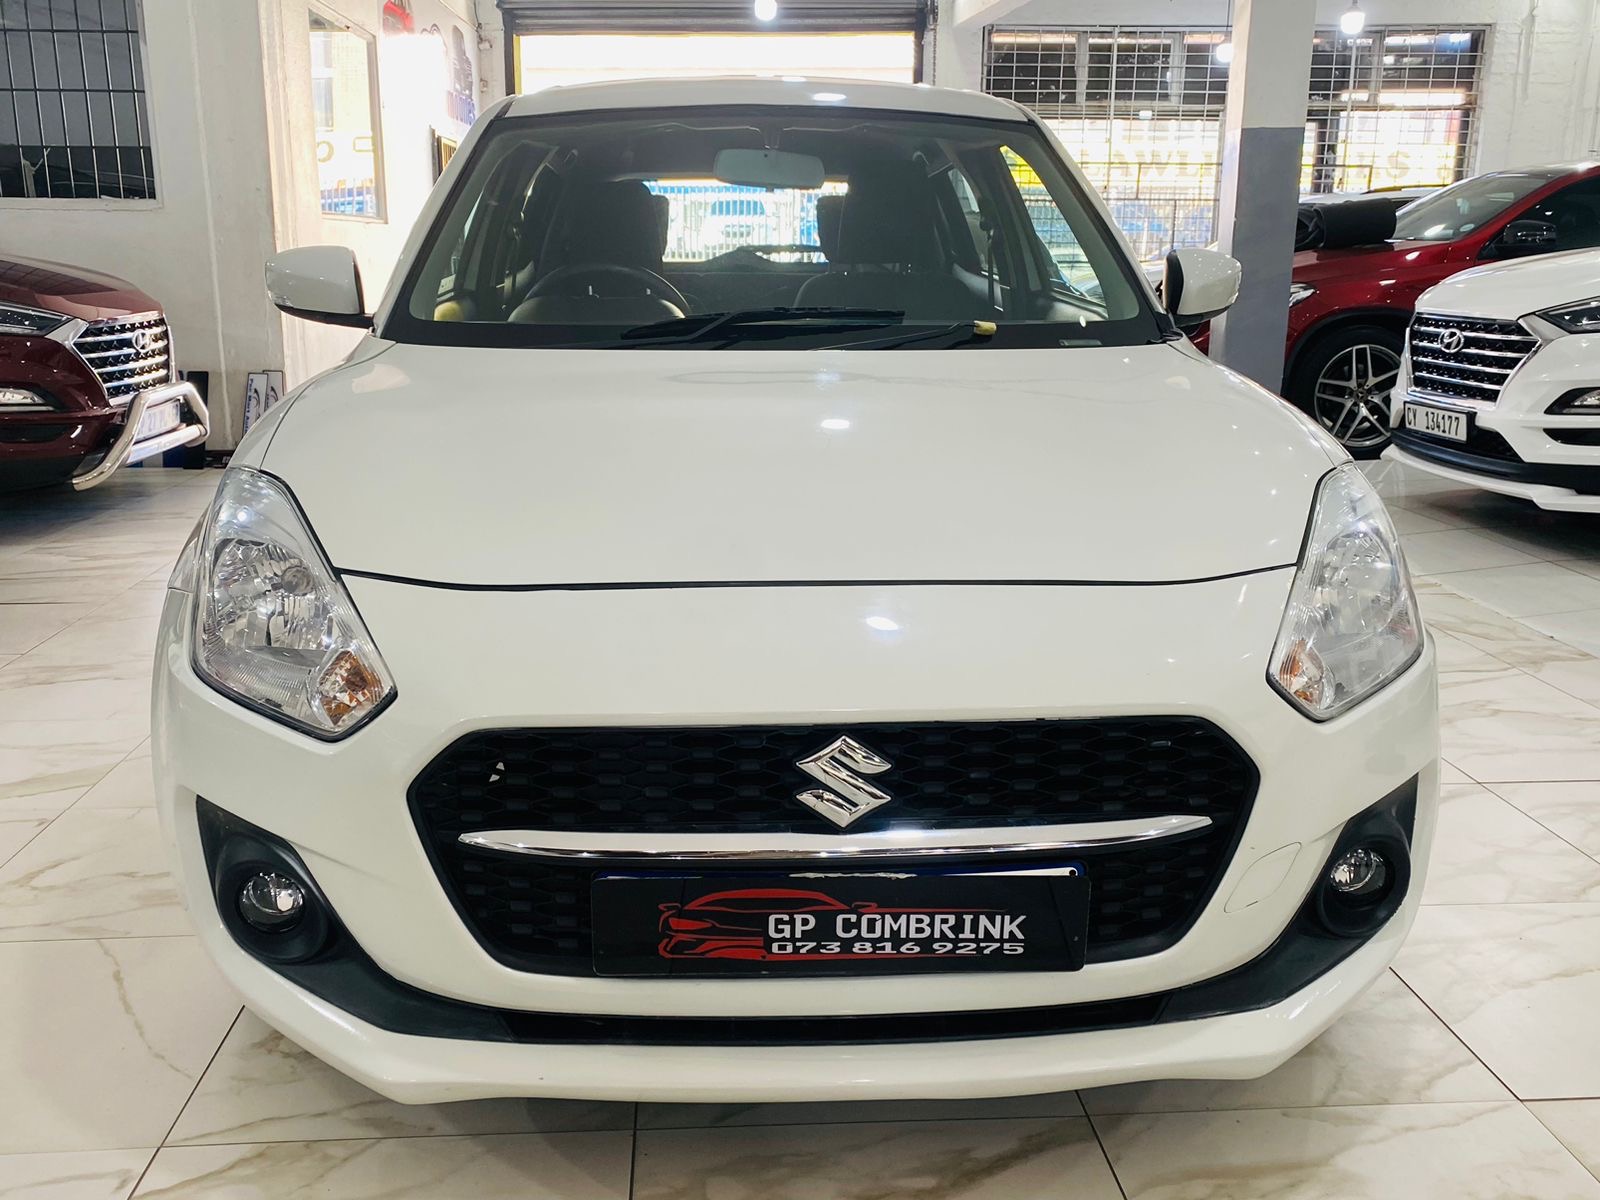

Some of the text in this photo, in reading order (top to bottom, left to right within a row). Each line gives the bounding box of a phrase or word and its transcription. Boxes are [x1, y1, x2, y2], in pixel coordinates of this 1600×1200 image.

[1407, 407, 1460, 436] CY 134177
[768, 914, 1027, 940] GP COMBRINK
[771, 942, 1025, 955] 073 816 9275
